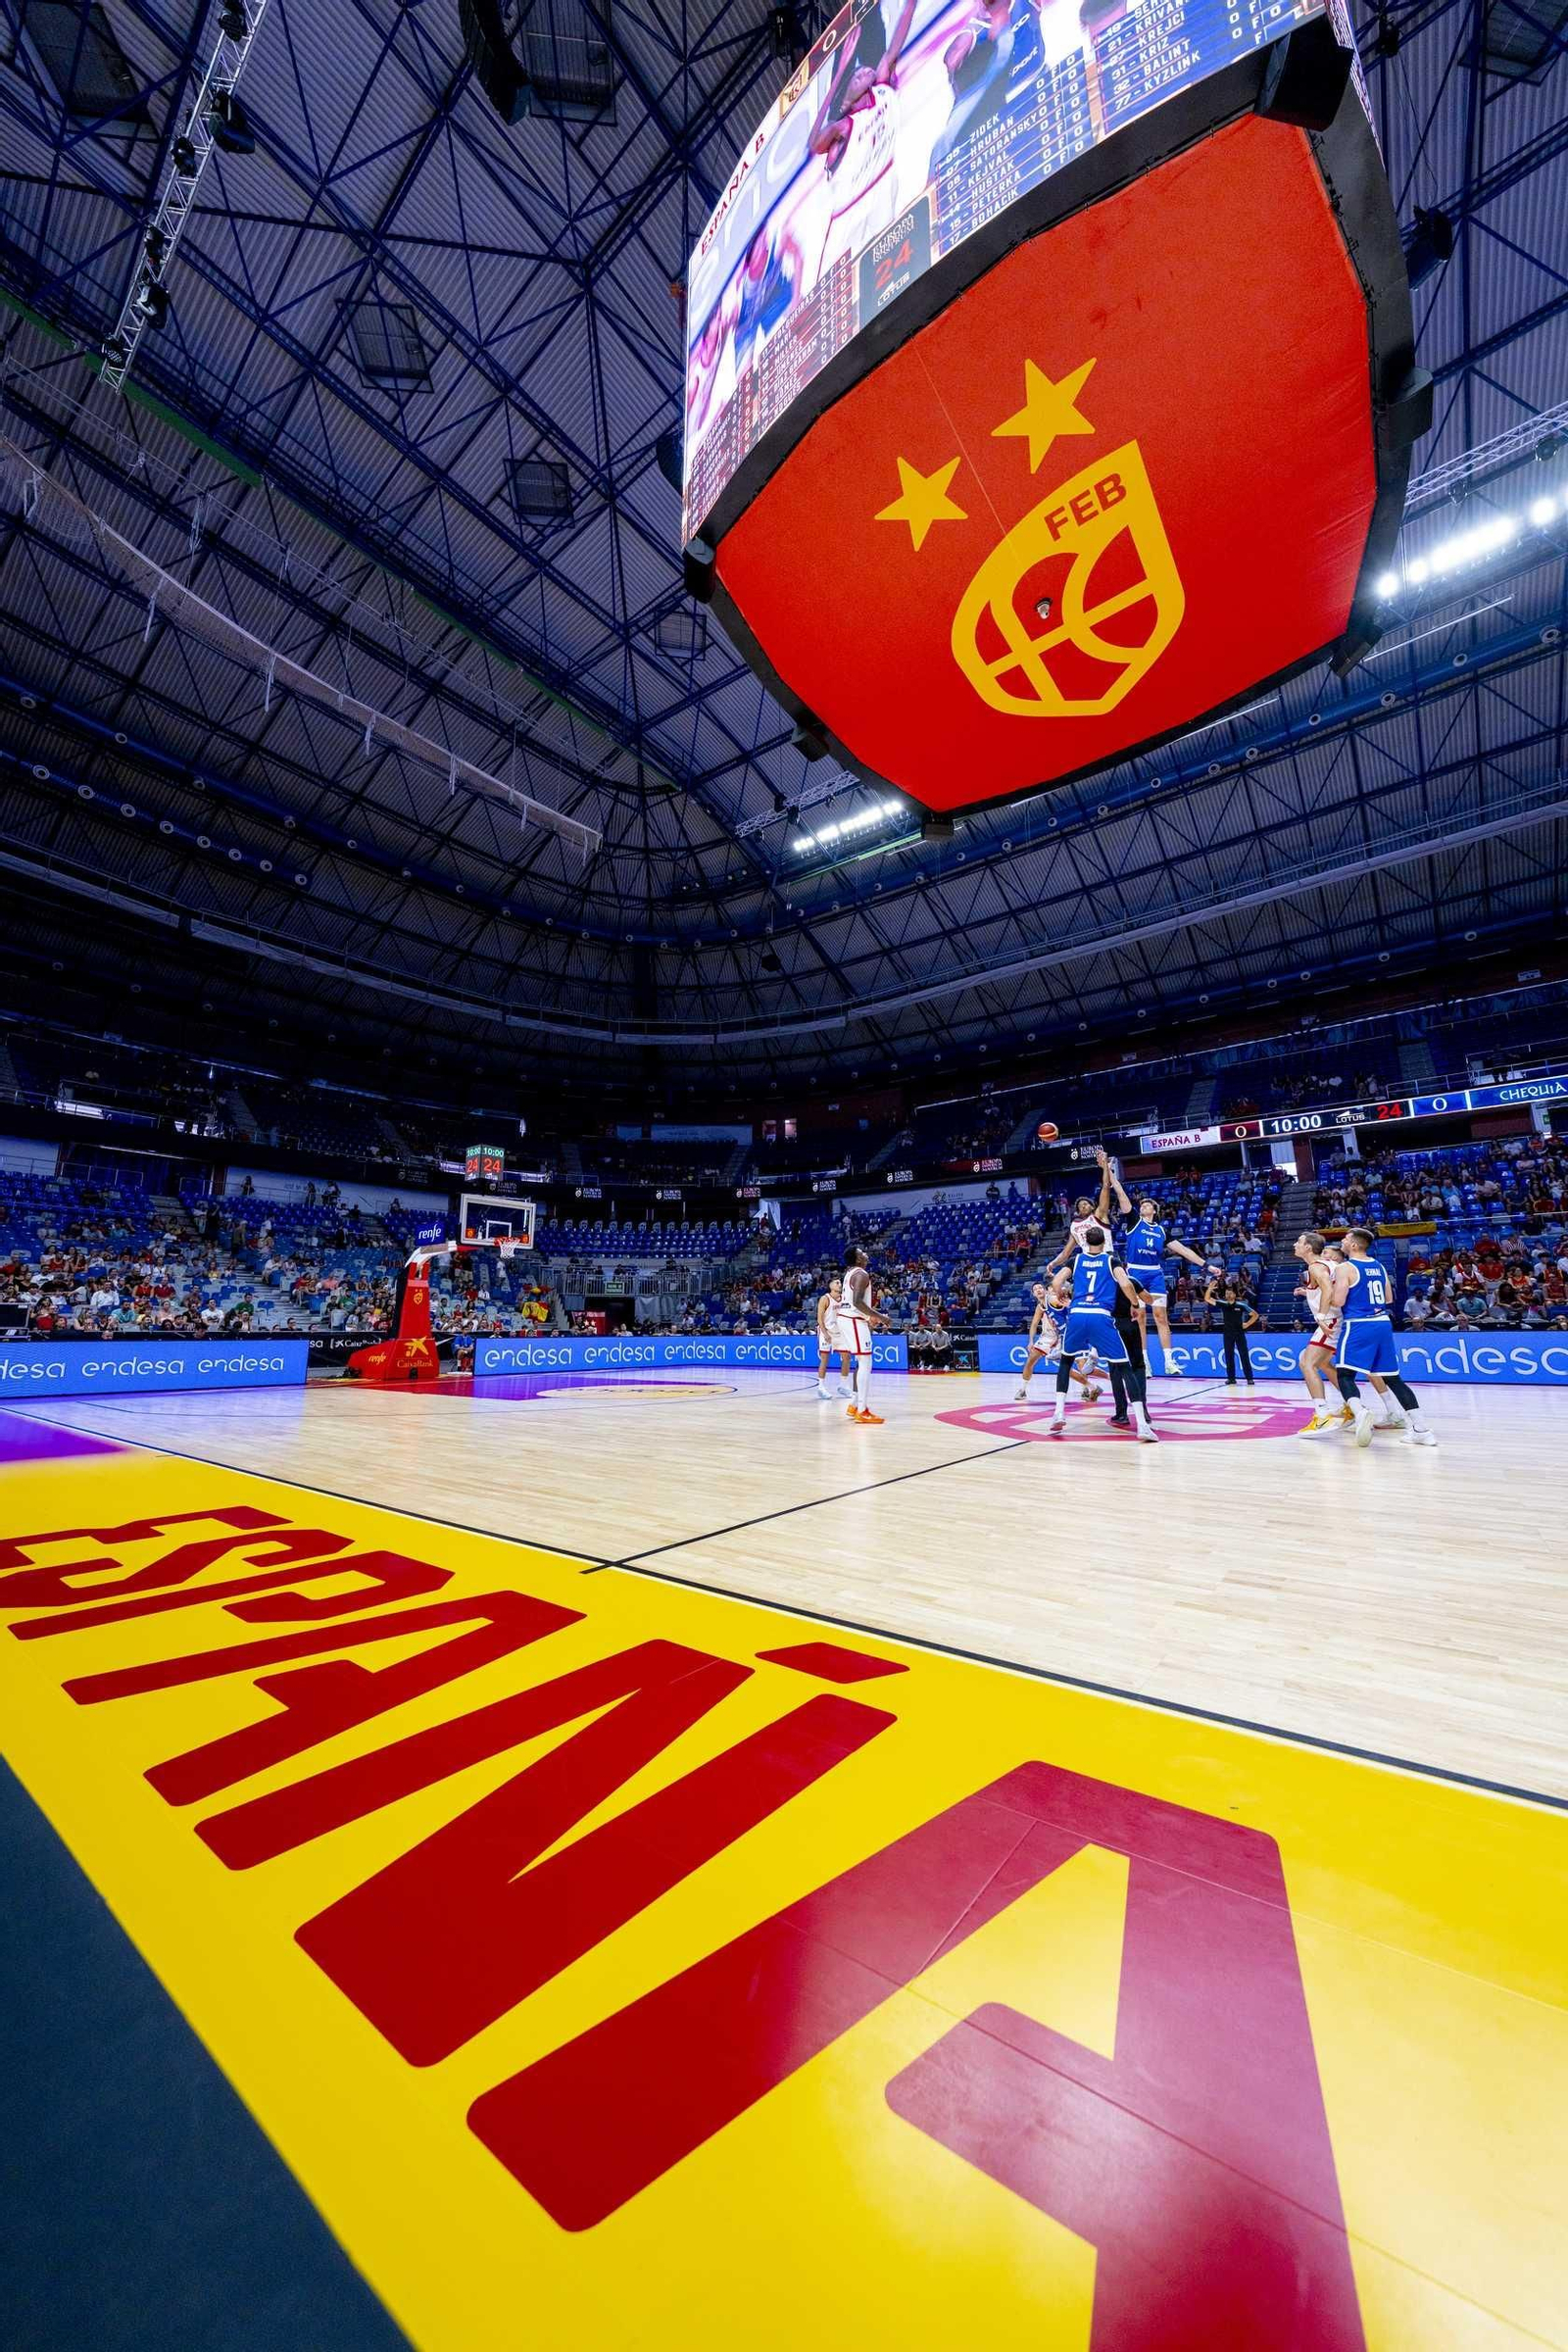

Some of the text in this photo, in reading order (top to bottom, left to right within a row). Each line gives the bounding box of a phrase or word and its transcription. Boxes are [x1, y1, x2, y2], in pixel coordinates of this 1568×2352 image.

[1140, 36, 1169, 63] KRIZ
[1144, 50, 1200, 91] KYZLINK
[970, 118, 1013, 157] HRUBAN
[970, 113, 1037, 171] SATORANSKY
[968, 151, 1008, 187] KEJVAL
[972, 171, 1020, 215] PETERKA
[1043, 472, 1127, 542] FEB
[1377, 1102, 1403, 1120] 24
[1432, 1097, 1447, 1111] 0
[1271, 1114, 1322, 1135] 10:00
[1336, 1113, 1365, 1125] LOTUS
[1152, 1134, 1201, 1150] ESPAÑA B
[1235, 1125, 1247, 1139] 0
[483, 1147, 505, 1157] 10:00
[484, 1157, 501, 1173] 24
[418, 1223, 442, 1243] renfe
[1087, 1270, 1098, 1293] 7
[1367, 1280, 1385, 1304] 19
[484, 1344, 572, 1368] endesa
[584, 1342, 656, 1364] endesa
[664, 1341, 726, 1360] endesa
[735, 1341, 806, 1361] endesa
[1170, 1347, 1306, 1371] enes
[1396, 1339, 1568, 1376] ndesa
[81, 1356, 184, 1377] endesa
[197, 1354, 284, 1374] endesa
[396, 1359, 434, 1368] CaixaBank
[0, 1505, 1366, 2352] ESPAÑA
